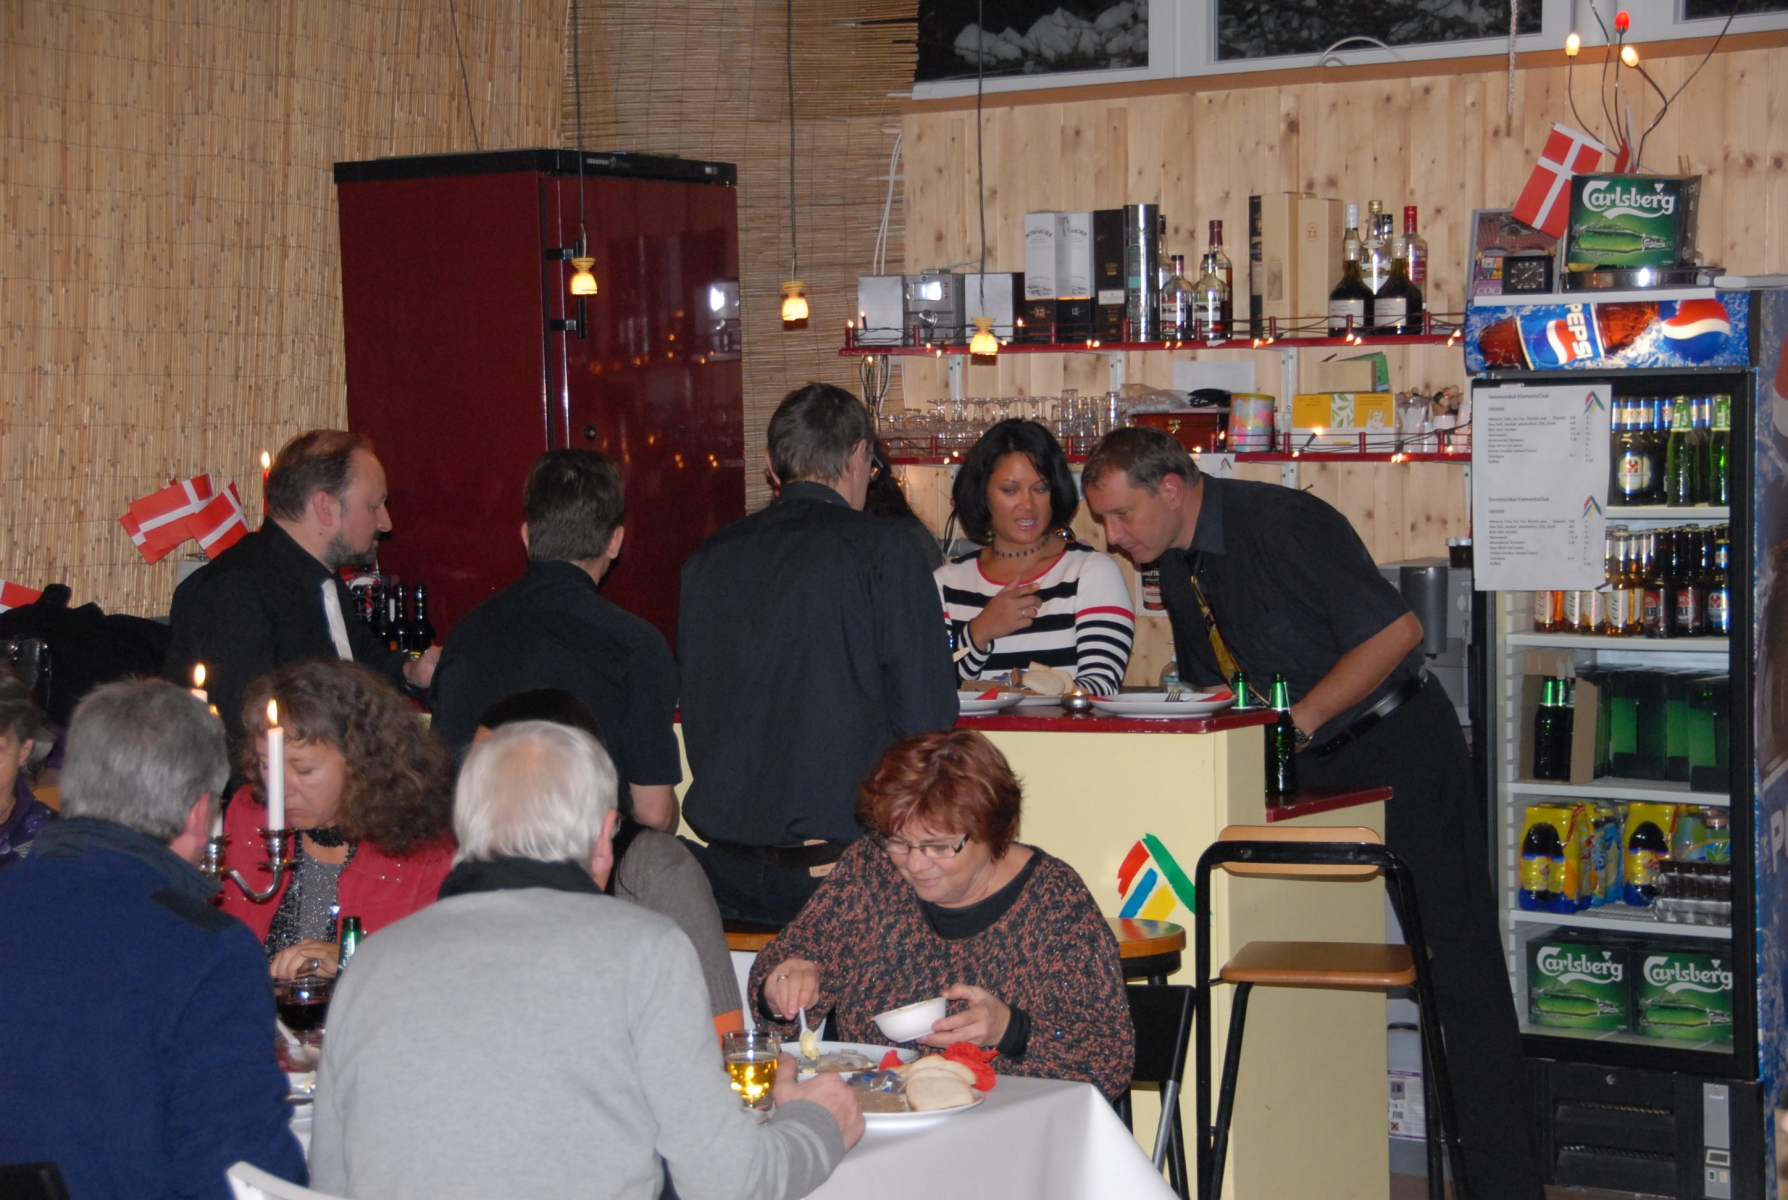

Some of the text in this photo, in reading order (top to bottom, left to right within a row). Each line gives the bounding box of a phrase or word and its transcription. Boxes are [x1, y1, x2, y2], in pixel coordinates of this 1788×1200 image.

[1582, 180, 1675, 217] Carlsberg
[1025, 229, 1053, 239] BOWMORE
[1071, 228, 1087, 237] MORE
[1564, 303, 1594, 359] PEPSI
[1610, 594, 1620, 620] eve
[1537, 946, 1623, 983] Carlsberg
[1643, 956, 1733, 991] Carlsberg
